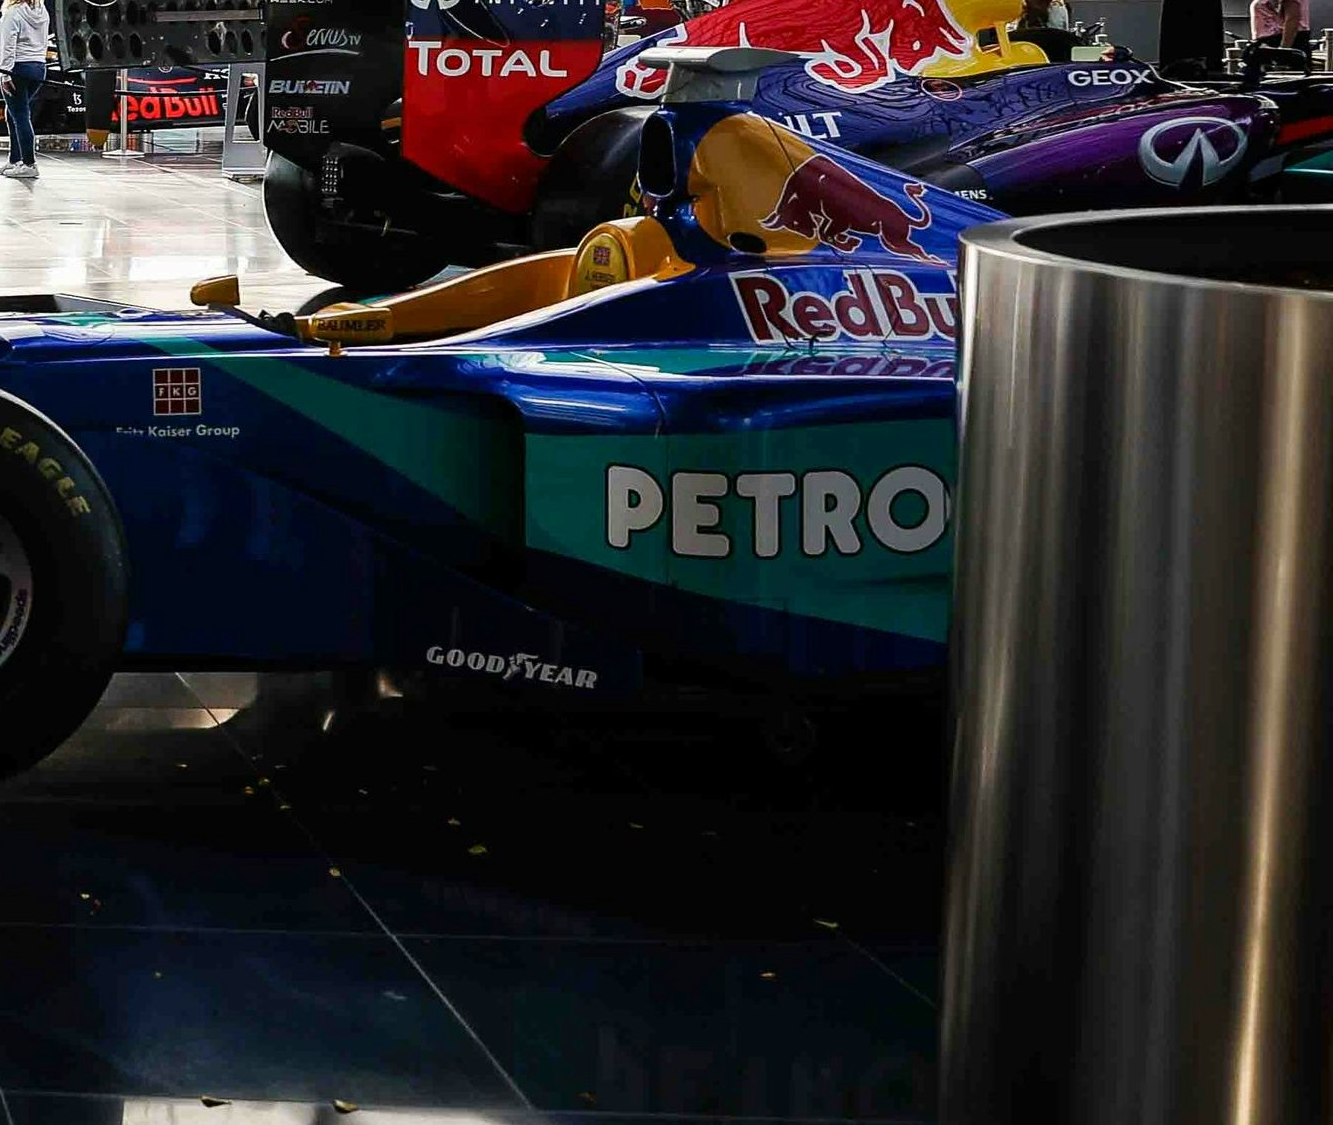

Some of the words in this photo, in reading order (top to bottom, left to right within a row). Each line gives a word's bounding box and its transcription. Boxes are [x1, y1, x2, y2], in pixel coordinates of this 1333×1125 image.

[408, 40, 568, 78] TOTAL
[1068, 69, 1154, 87] GEOX
[148, 425, 192, 437] Kaiser
[195, 423, 241, 440] Group
